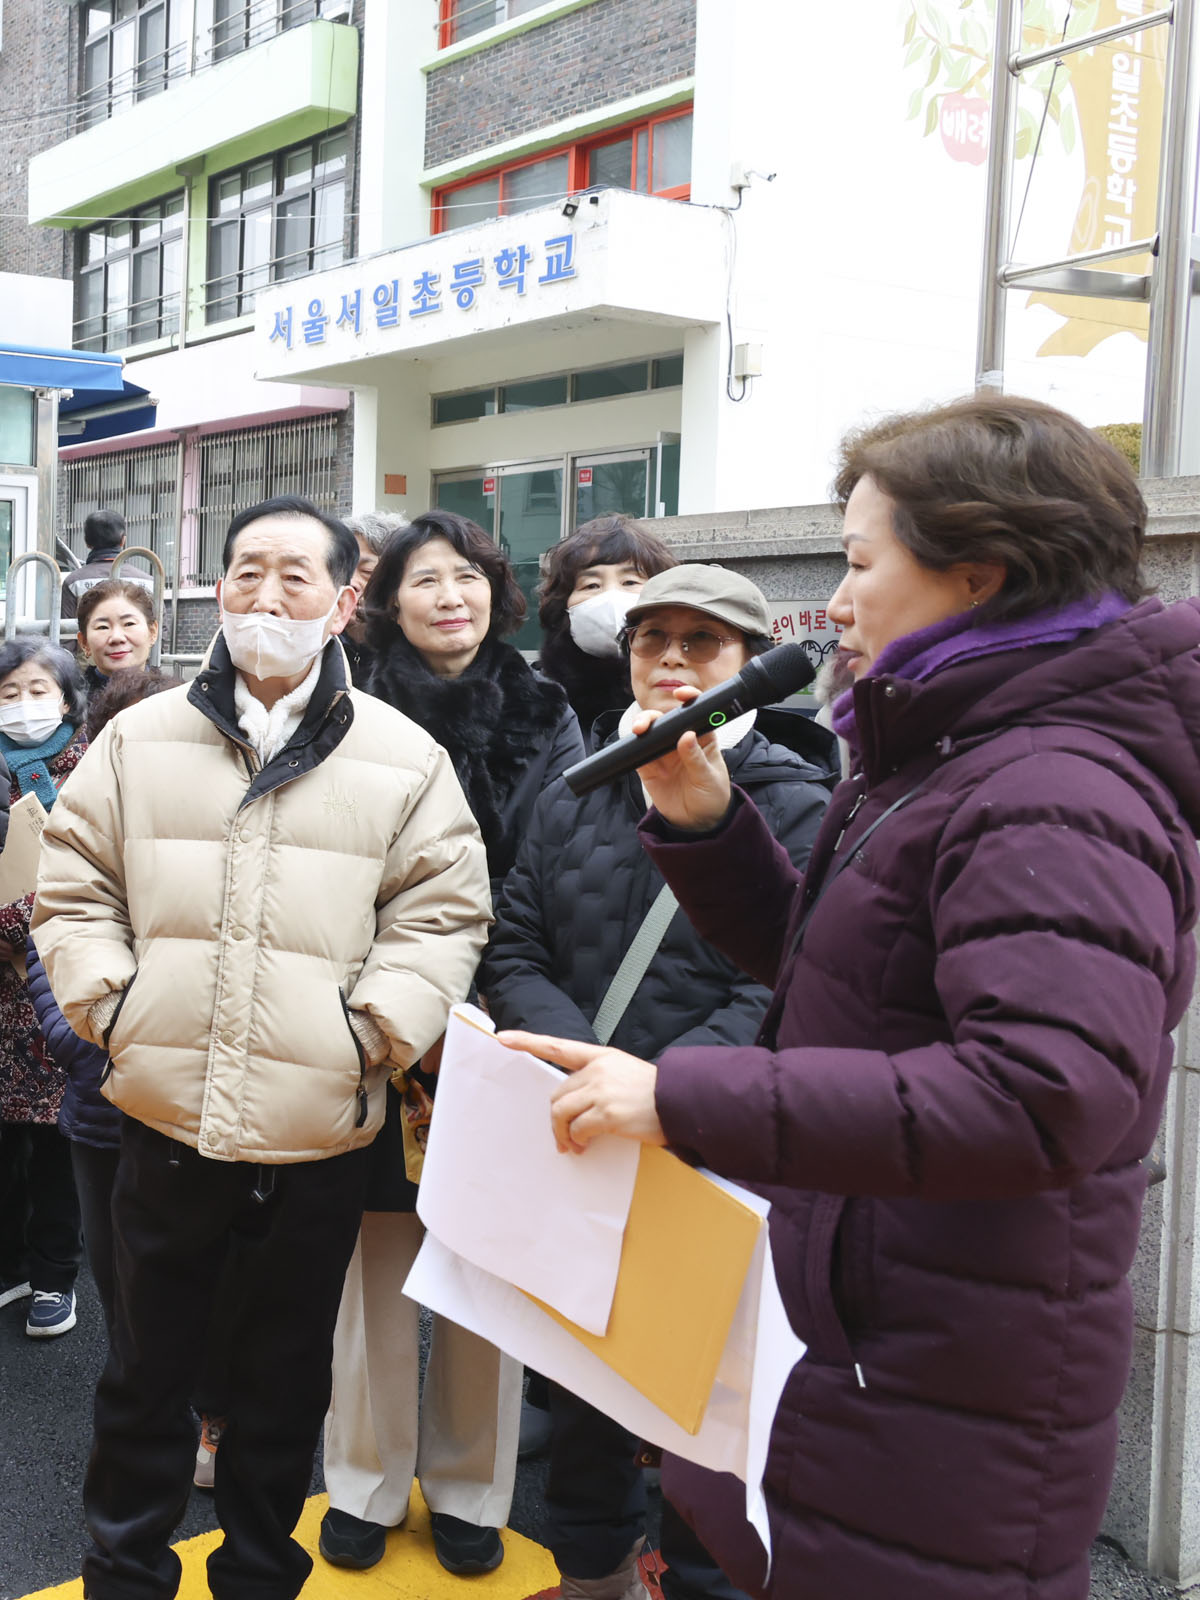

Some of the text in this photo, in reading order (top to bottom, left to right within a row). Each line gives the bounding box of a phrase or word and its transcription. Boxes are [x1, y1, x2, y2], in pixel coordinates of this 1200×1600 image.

[1101, 0, 1143, 249] 서일초등학교
[269, 233, 577, 349] 서울서일초등학교
[799, 609, 827, 633] 바로
